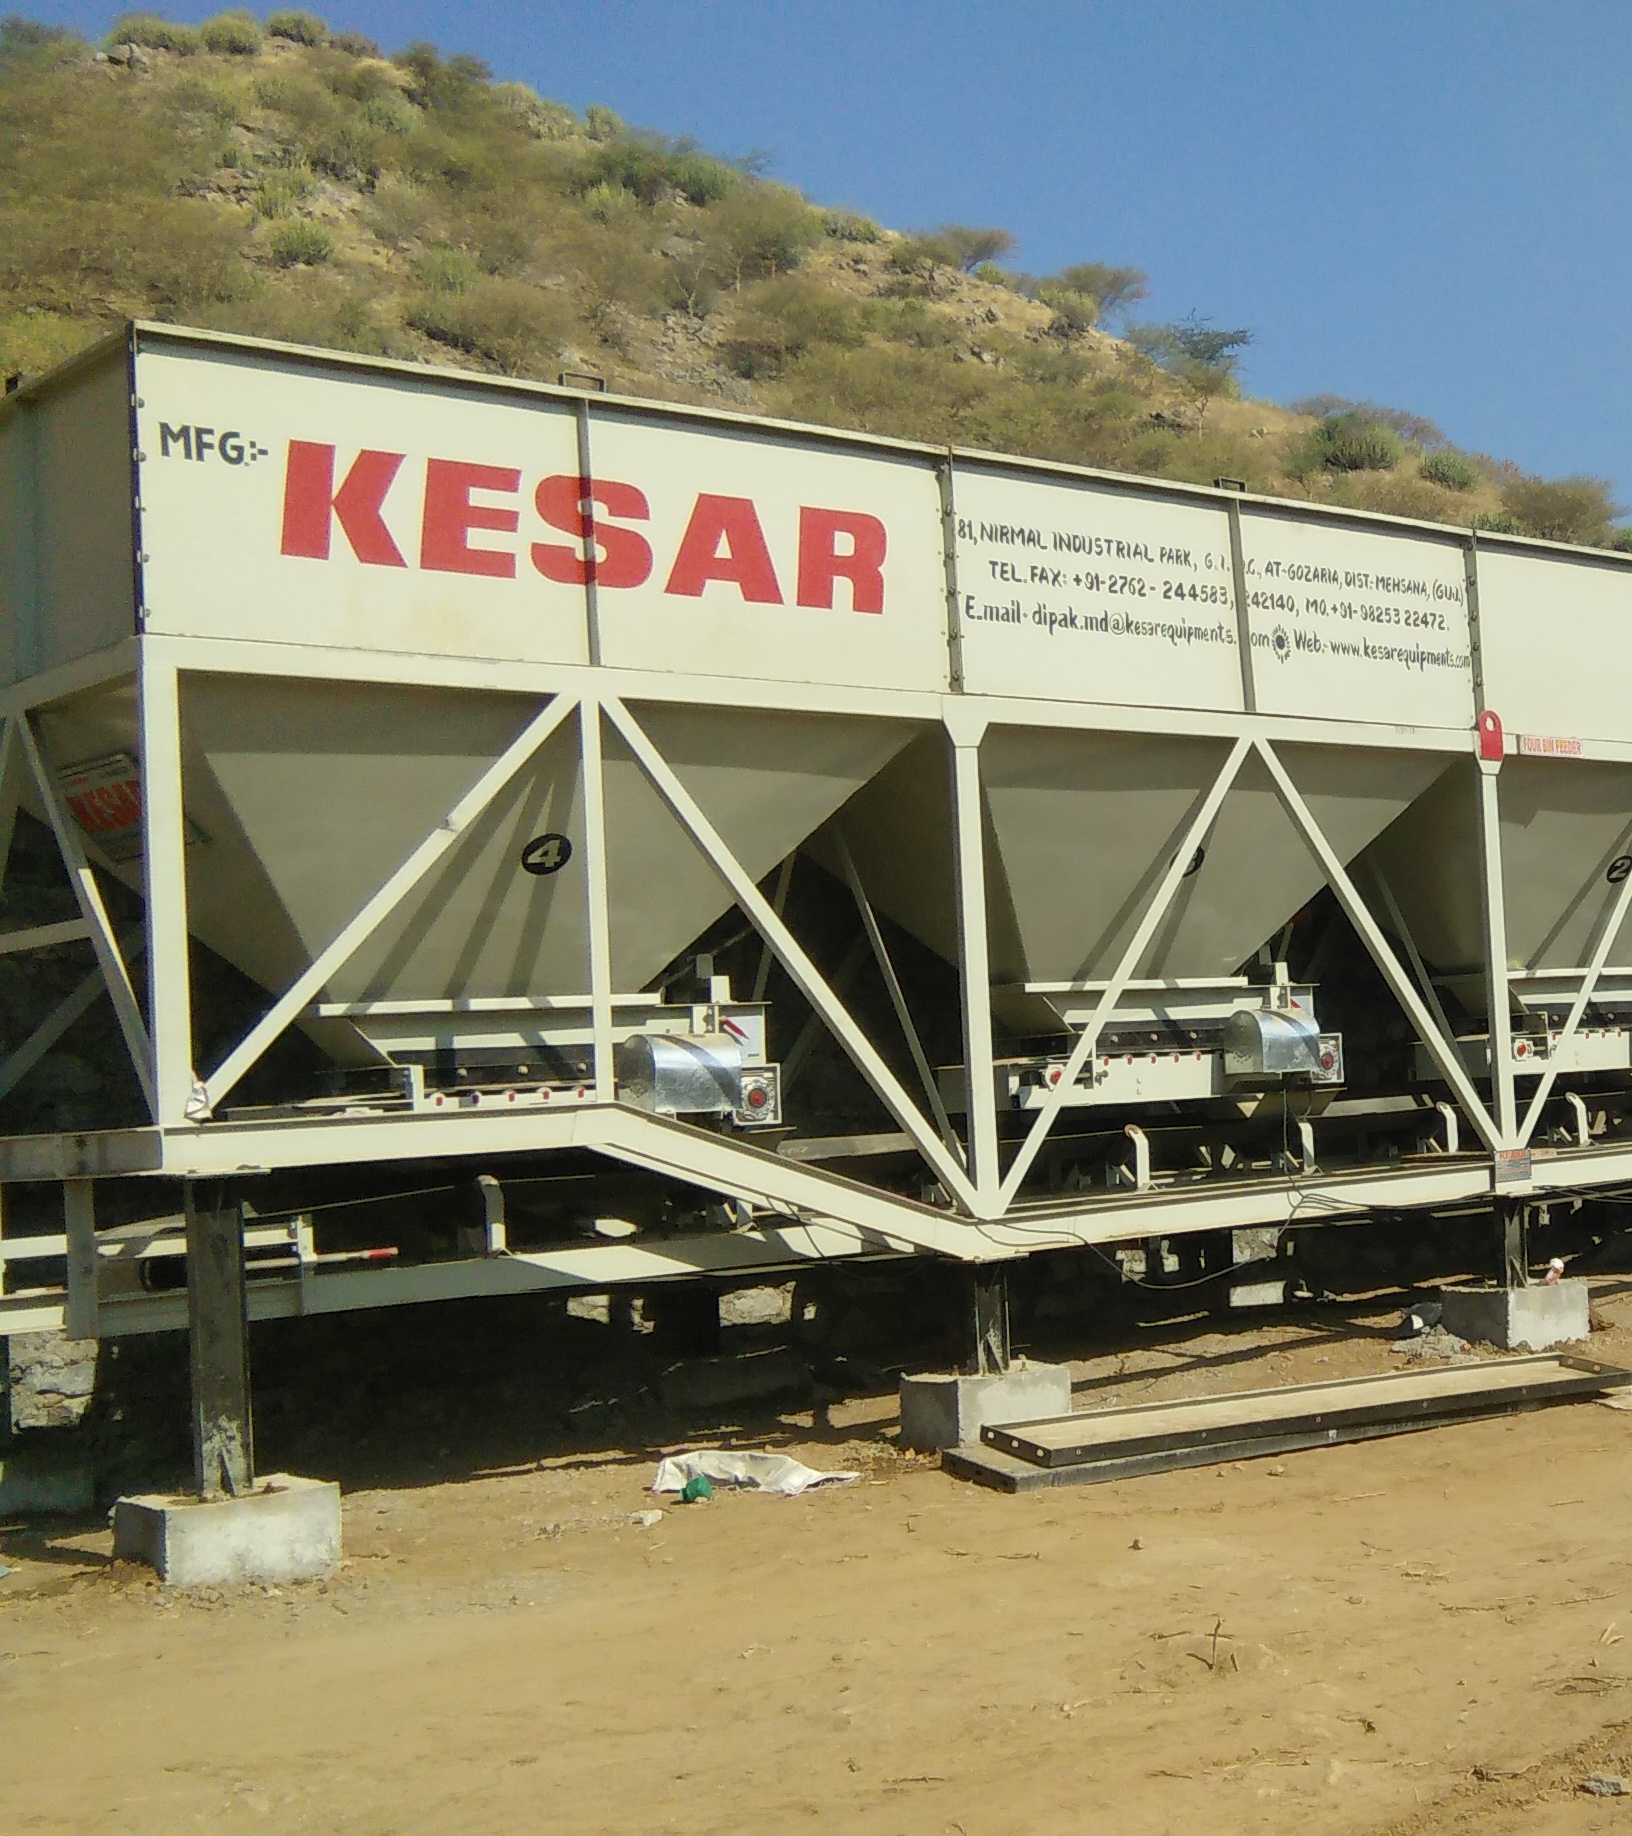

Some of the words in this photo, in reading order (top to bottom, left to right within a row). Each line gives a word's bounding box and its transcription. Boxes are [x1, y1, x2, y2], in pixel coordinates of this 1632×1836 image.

[280, 439, 887, 614] KESAR
[1052, 531, 1154, 562] INDUSTRIAL
[1160, 546, 1197, 572] PARK,
[1608, 858, 1632, 880] 2
